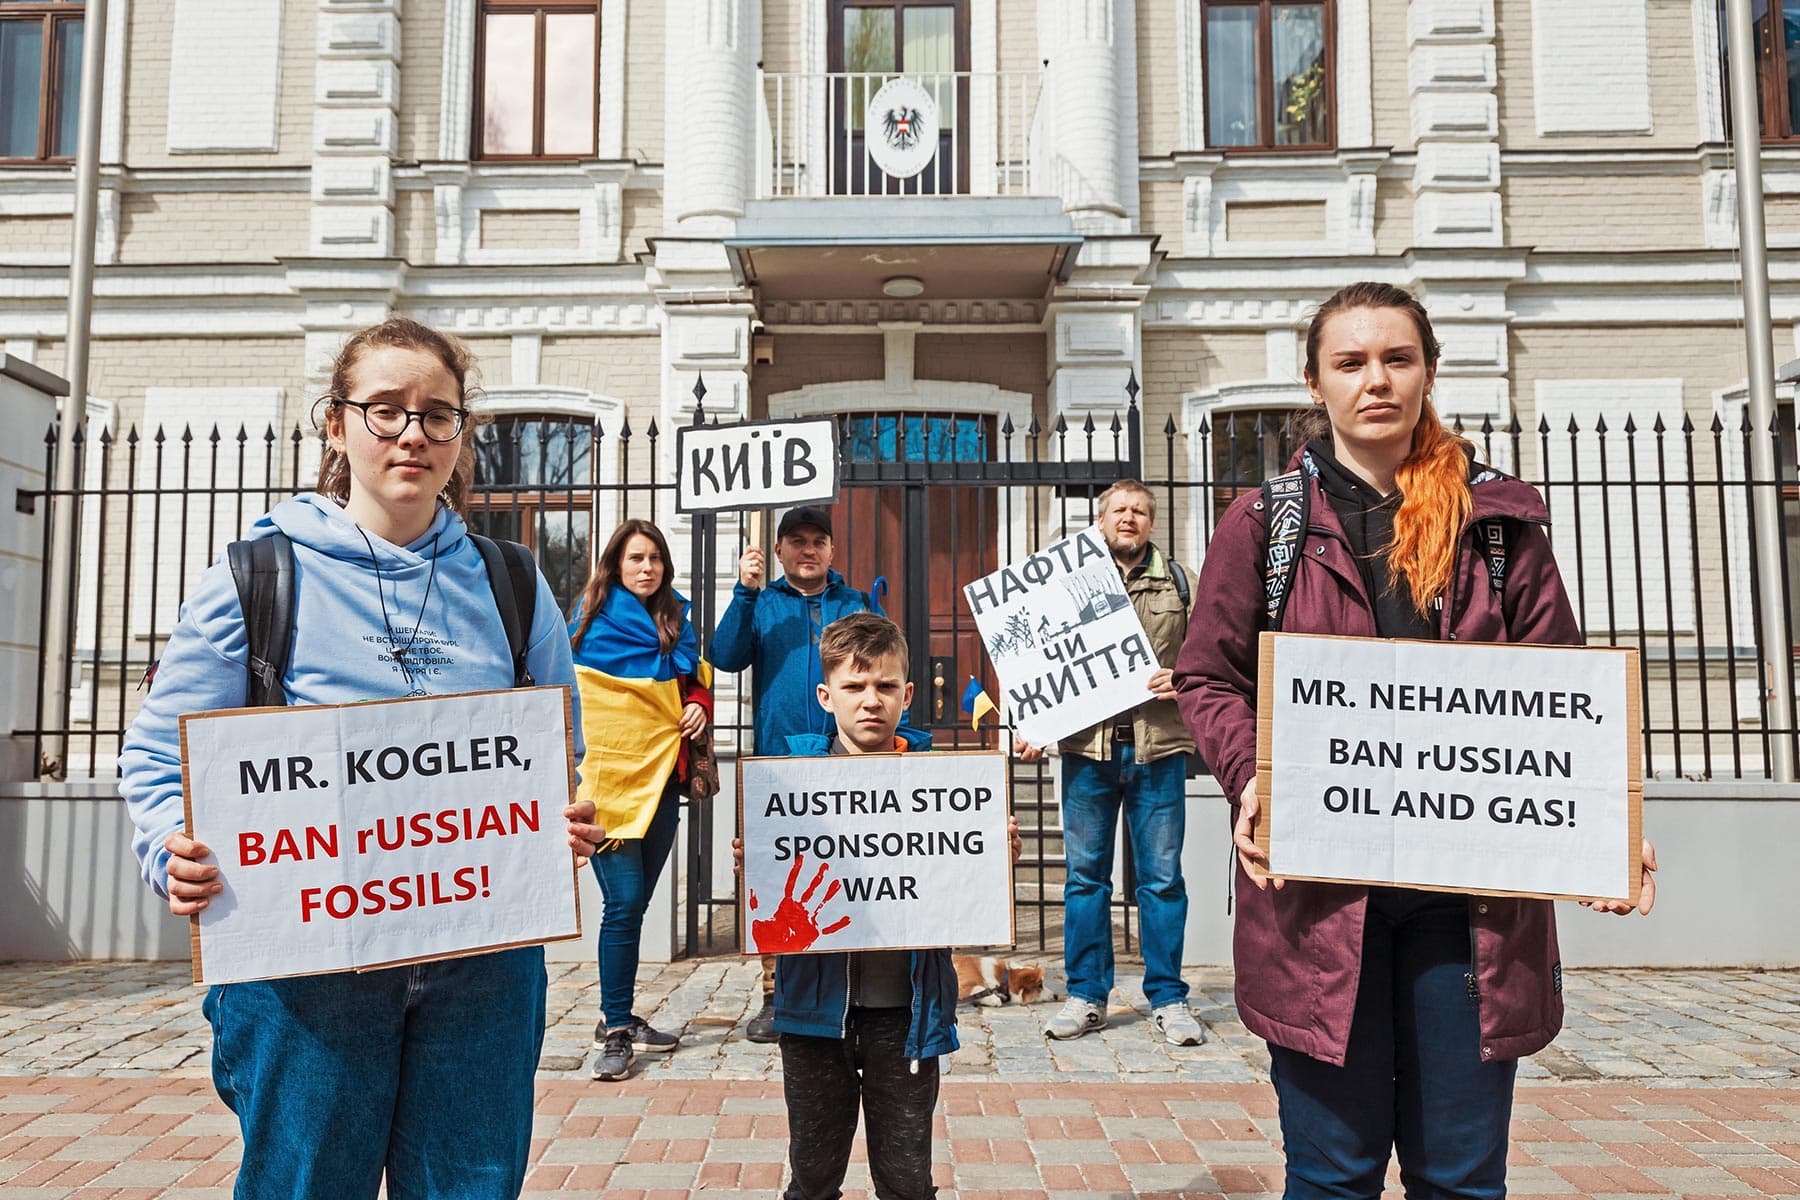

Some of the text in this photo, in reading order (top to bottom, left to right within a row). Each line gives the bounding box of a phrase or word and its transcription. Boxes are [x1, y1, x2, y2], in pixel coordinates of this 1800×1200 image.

[691, 429, 817, 496] КИЇВ
[968, 531, 1107, 616] НАФТА
[377, 654, 402, 663] ВОН
[1043, 632, 1088, 664] ЧИ
[1008, 632, 1152, 722] ЖИТТЯ
[1292, 677, 1603, 725] MR. NEHAMMER,
[240, 735, 532, 795] MR. KOGLER,
[1329, 738, 1571, 778] BAN rUSSIAN
[764, 787, 992, 818] AUSTRIA STOP
[1323, 785, 1576, 828] OIL AND GAS!
[238, 800, 540, 867] BAN rUSSIAN
[774, 831, 984, 861] SPONSORING
[300, 865, 490, 923] FOSSILS!
[842, 876, 919, 902] WAR
